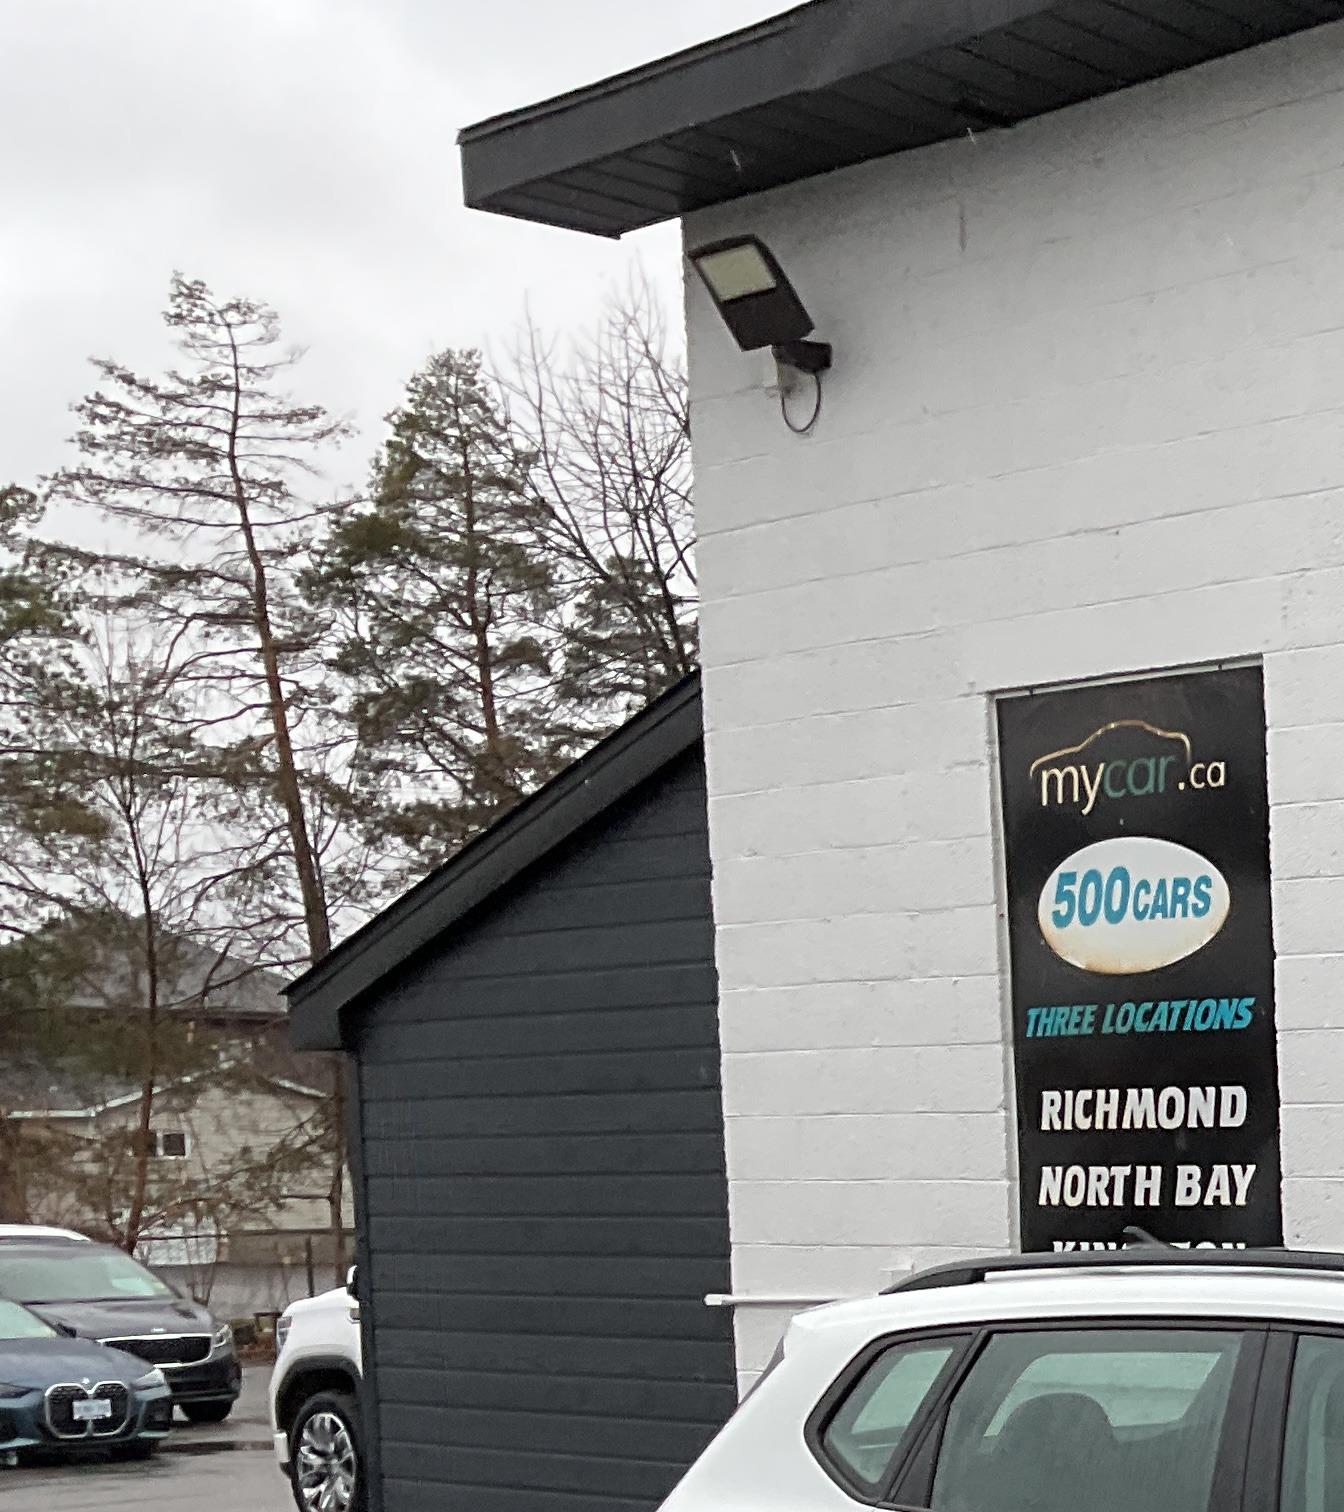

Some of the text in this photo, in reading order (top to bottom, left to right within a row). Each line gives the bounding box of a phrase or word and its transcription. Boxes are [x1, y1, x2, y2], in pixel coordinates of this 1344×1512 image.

[1040, 755, 1226, 815] mycar.ca
[1025, 997, 1256, 1038] THREE LOCATIONS
[1040, 1085, 1248, 1131] RICHMOND
[1038, 1164, 1257, 1207] NORTH BAY
